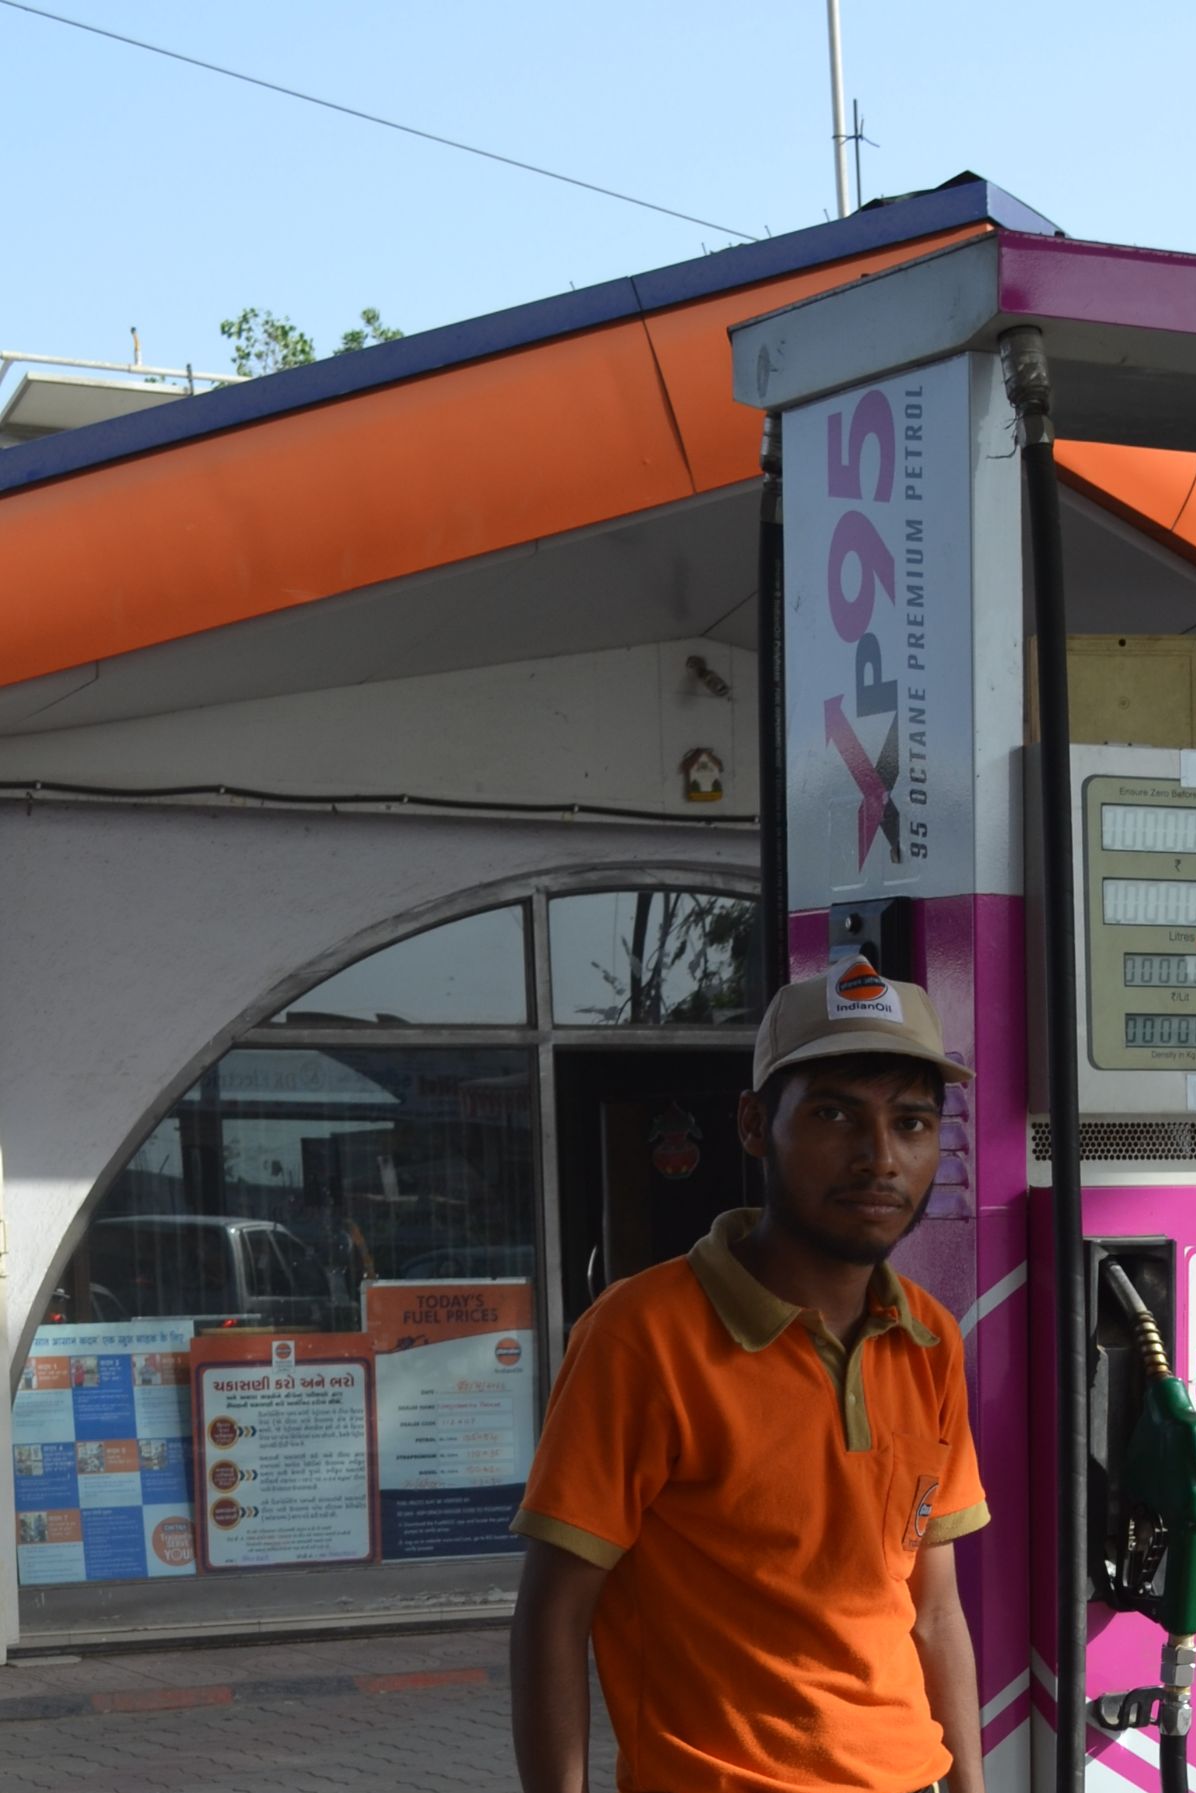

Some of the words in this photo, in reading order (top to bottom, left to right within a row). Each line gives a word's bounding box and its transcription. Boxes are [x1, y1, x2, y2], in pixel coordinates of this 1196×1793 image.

[904, 386, 923, 500] PETROL
[906, 519, 926, 670] PREMIUM
[824, 389, 897, 873] XP95
[908, 686, 928, 807] OCTANE
[1119, 787, 1149, 797] Ensure
[1150, 789, 1169, 798] Zero
[910, 822, 928, 859] 95
[1169, 931, 1195, 942] Litres
[836, 1002, 893, 1013] IndianOil
[1152, 1050, 1177, 1061] Density
[1187, 1051, 1196, 1061] Kg
[416, 1294, 485, 1309] TODAY'S
[402, 1310, 442, 1324] FUEL
[446, 1309, 499, 1322] PRICES
[213, 1375, 271, 1393] ચકાસણી
[274, 1375, 296, 1391] કરો
[300, 1373, 326, 1389] અને
[330, 1372, 355, 1388] ભરો
